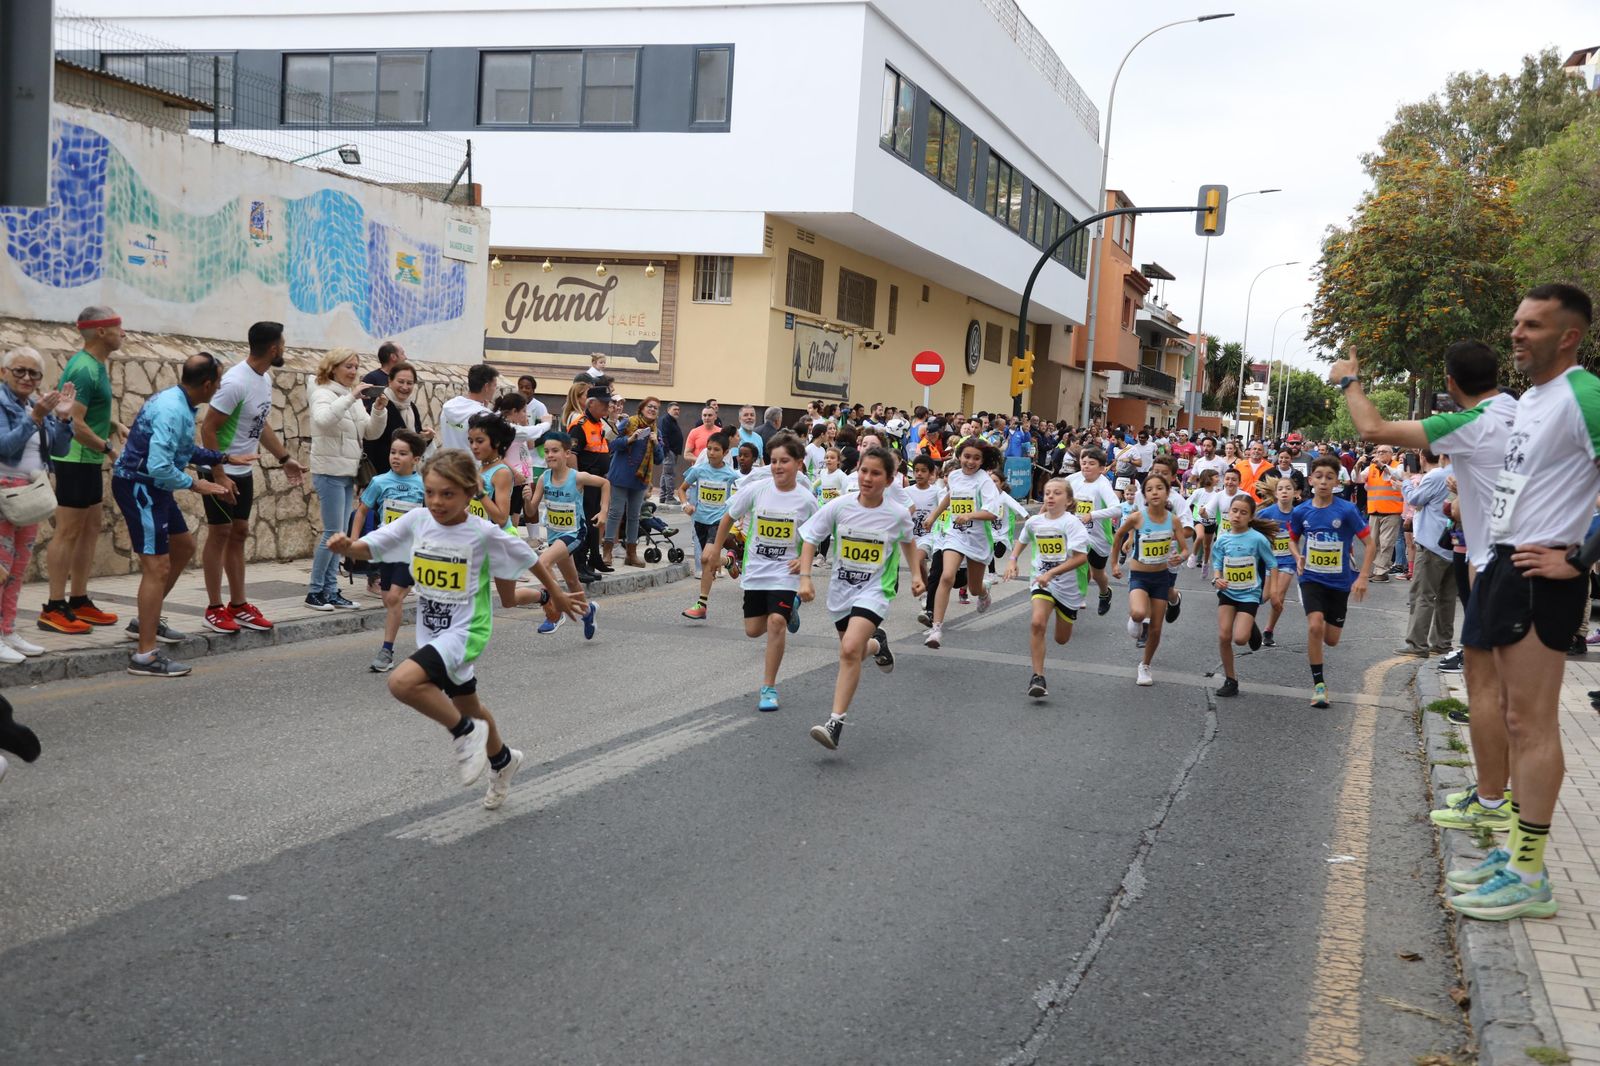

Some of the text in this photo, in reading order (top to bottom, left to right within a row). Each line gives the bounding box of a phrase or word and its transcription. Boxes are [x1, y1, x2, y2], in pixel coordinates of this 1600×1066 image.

[501, 275, 618, 334] Grand
[608, 312, 646, 328] CAFÉ
[807, 340, 838, 379] Grand
[702, 492, 723, 502] 1057
[951, 504, 972, 514] 1033
[548, 514, 572, 526] 1020
[760, 524, 790, 538] 1023
[1038, 542, 1062, 554] 1039
[1144, 544, 1169, 556] 1016
[1274, 542, 1289, 550] 103
[843, 546, 880, 562] 1049
[1310, 555, 1338, 566] 1034
[416, 566, 461, 590] 1051
[1226, 570, 1253, 582] 1004
